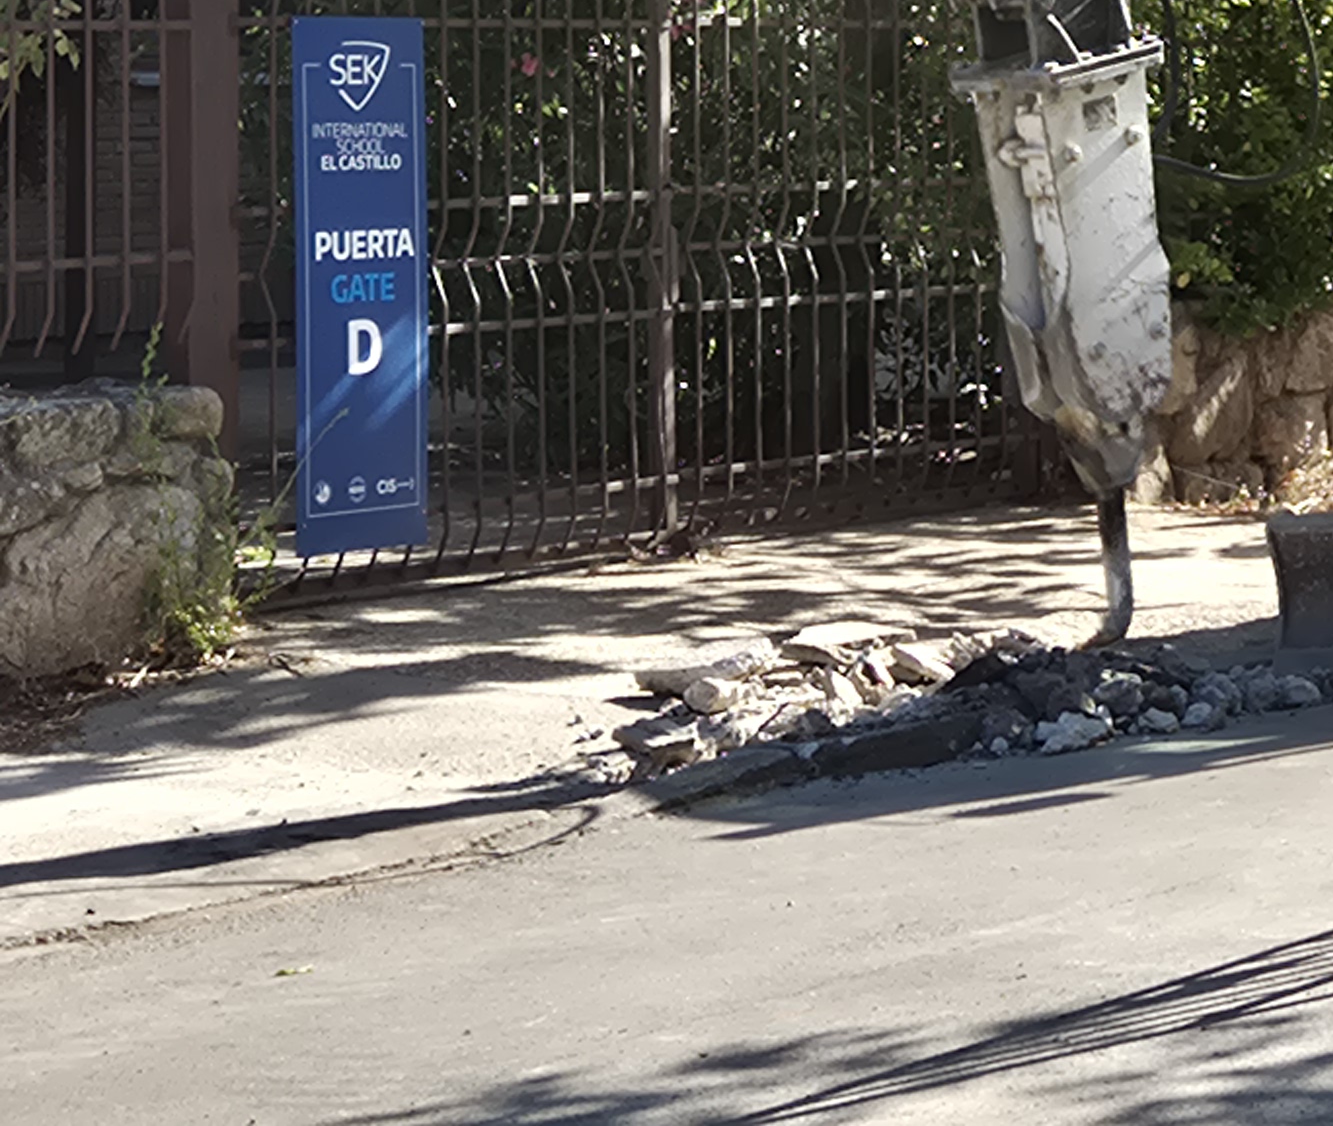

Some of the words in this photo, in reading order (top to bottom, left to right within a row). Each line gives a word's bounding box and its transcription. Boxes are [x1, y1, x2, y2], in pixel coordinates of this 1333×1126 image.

[328, 53, 381, 86] SEK
[311, 121, 408, 138] INTERNATIONAL
[321, 155, 337, 171] EL
[338, 153, 402, 171] CASTILLO
[336, 137, 385, 155] SCHOOL
[315, 227, 415, 261] PUERTA
[331, 272, 396, 304] GATE
[347, 318, 383, 376] D
